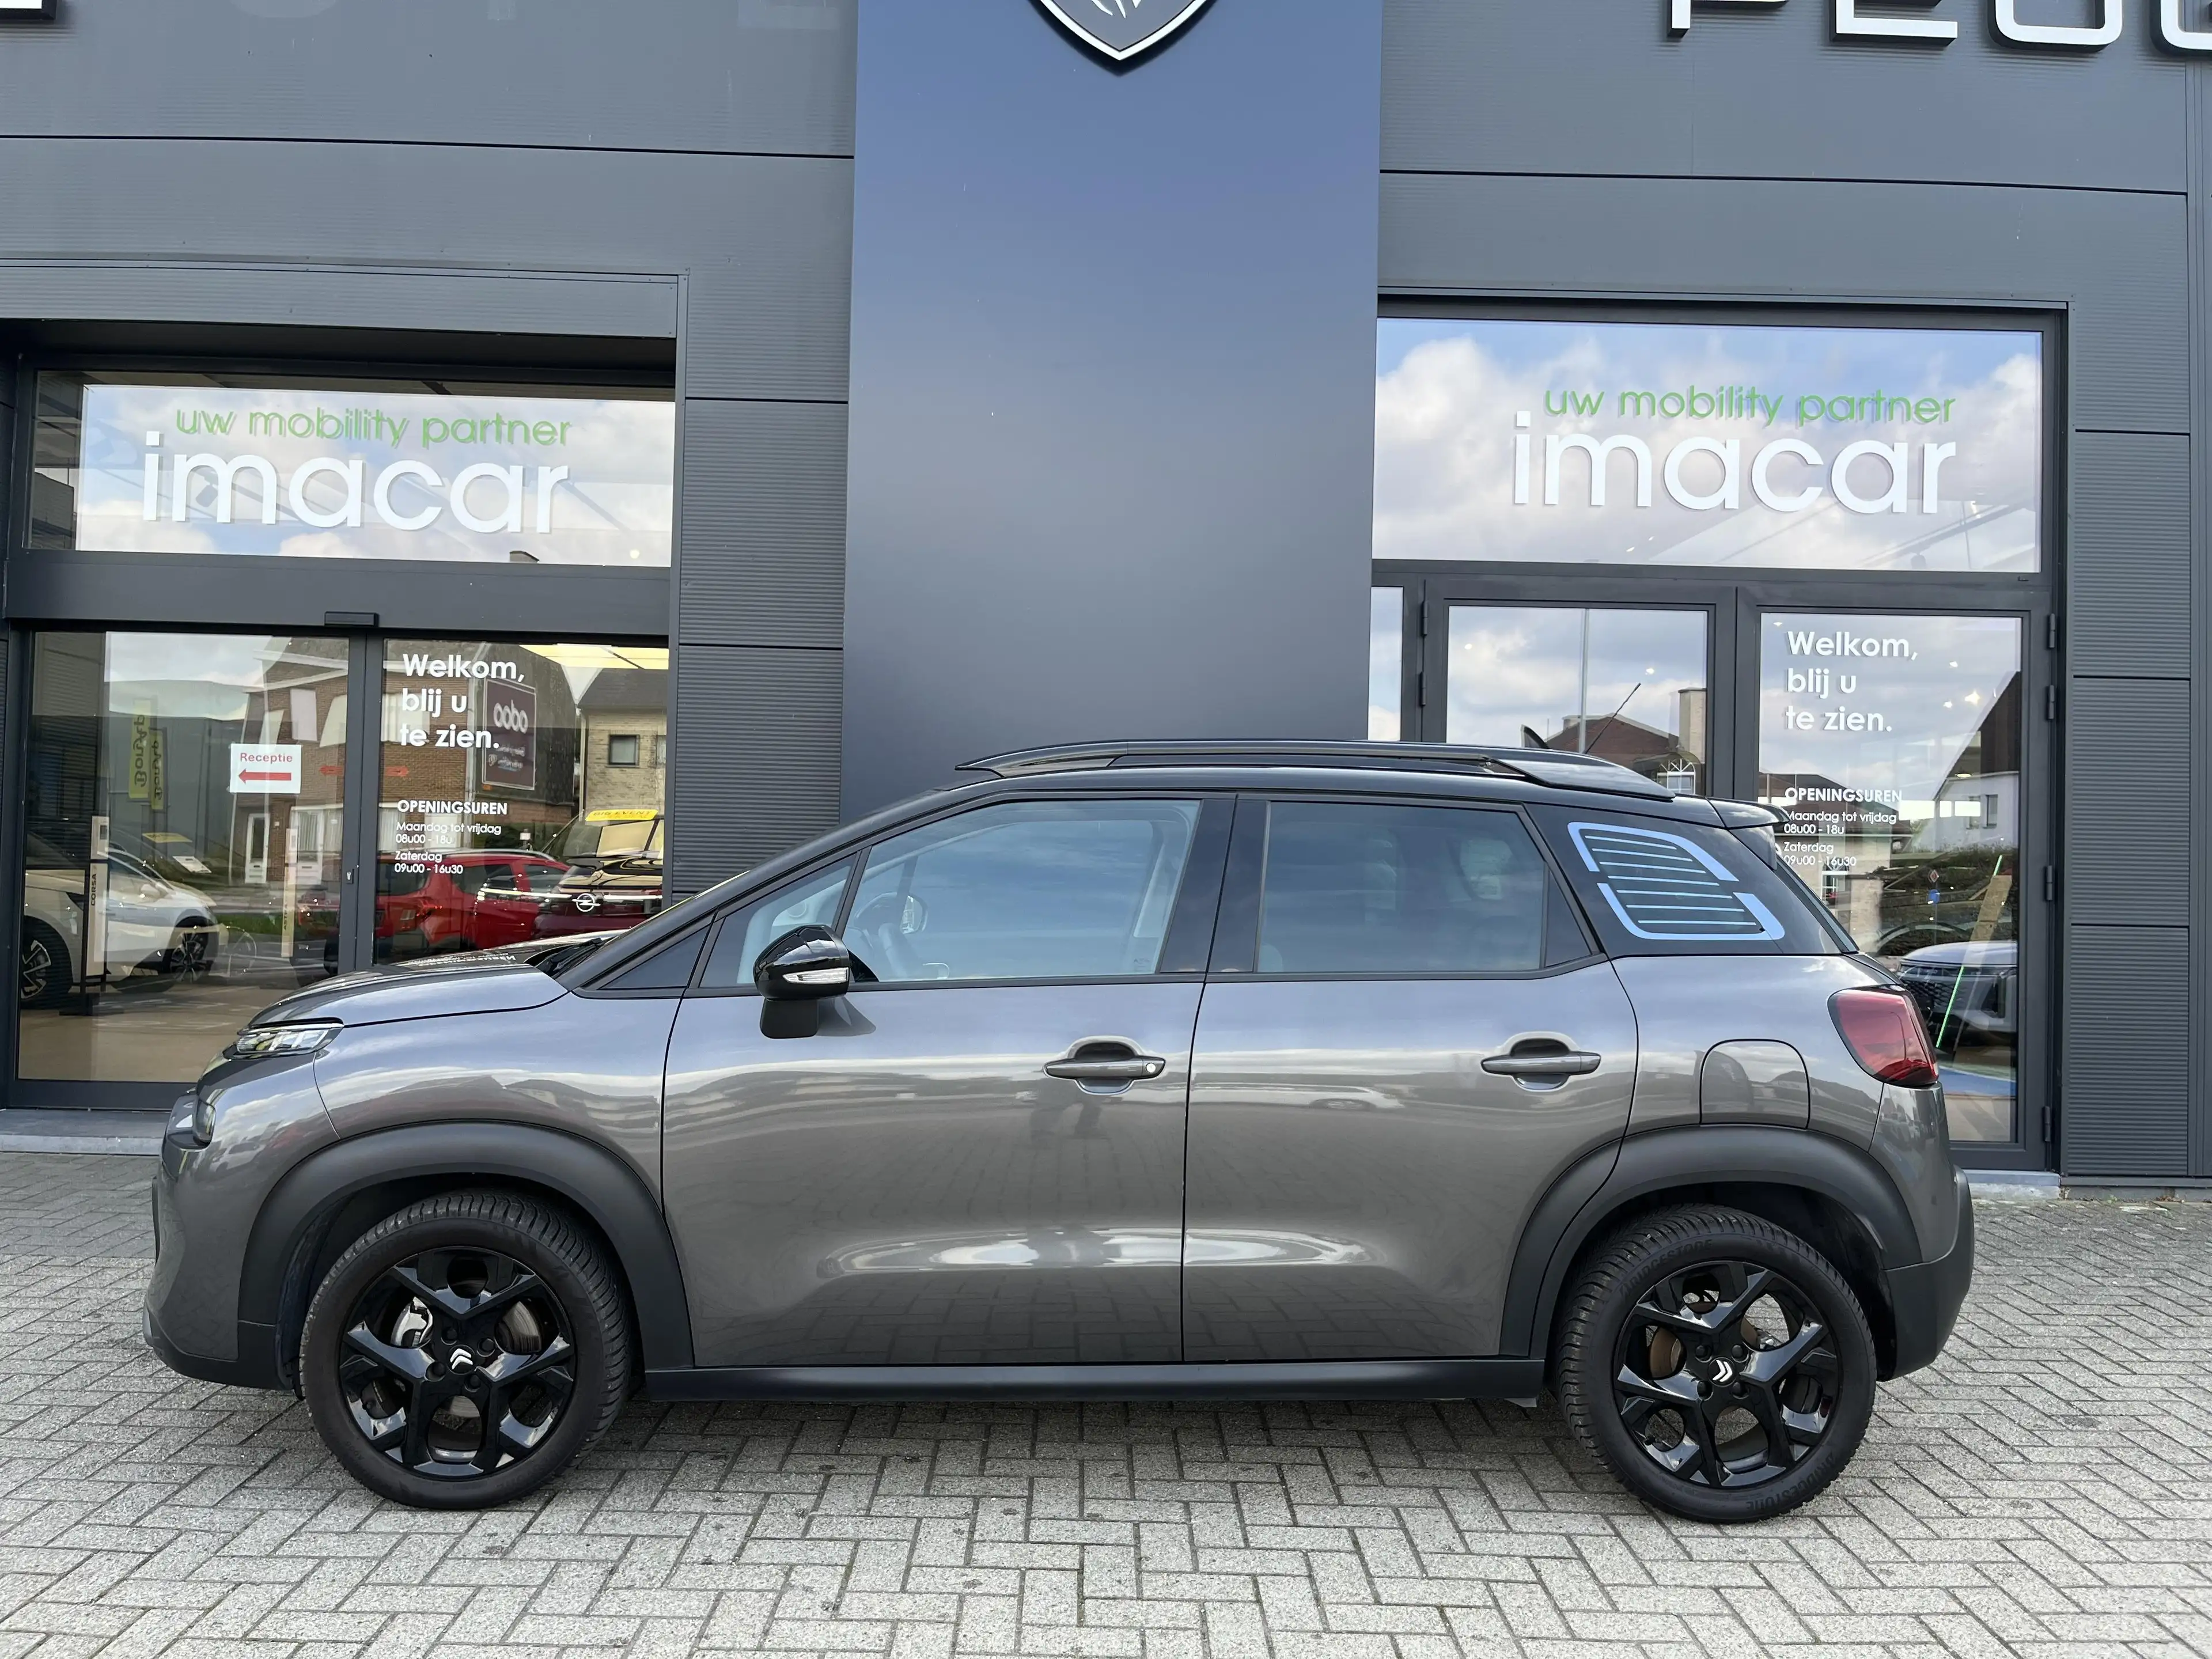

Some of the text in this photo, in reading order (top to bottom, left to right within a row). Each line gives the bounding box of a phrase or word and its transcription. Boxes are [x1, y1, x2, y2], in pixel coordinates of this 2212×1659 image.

[1546, 385, 1956, 427] uw mobility partner
[176, 407, 572, 449] uw mobility partner
[1514, 410, 1956, 514] imacar
[143, 431, 568, 533] imacar
[1787, 631, 1918, 661] Welkom,
[403, 653, 525, 683] Welkom,
[1787, 668, 1856, 699] blij u
[402, 688, 467, 718] blij u
[1786, 706, 1892, 732] te zien.
[400, 724, 499, 748] te zien.
[240, 752, 293, 763] Receptie
[1785, 787, 1902, 802] OPENINGSUREN
[397, 800, 507, 815] OPENINGSUREN
[1786, 811, 1897, 824] Maandag tot vrijdag
[396, 822, 502, 835] Maandag tot vrijdag
[1784, 824, 1816, 834] 08u00
[1826, 825, 1844, 835] 18u
[396, 835, 426, 843] 08u00
[435, 835, 453, 844] 18u
[1784, 842, 1834, 854] Zaterdag
[395, 851, 442, 863] Zaterdag
[1784, 855, 1816, 865] 09u00
[1826, 857, 1856, 866] 16u30
[395, 864, 425, 873] 09u00
[434, 865, 464, 874] 16u30
